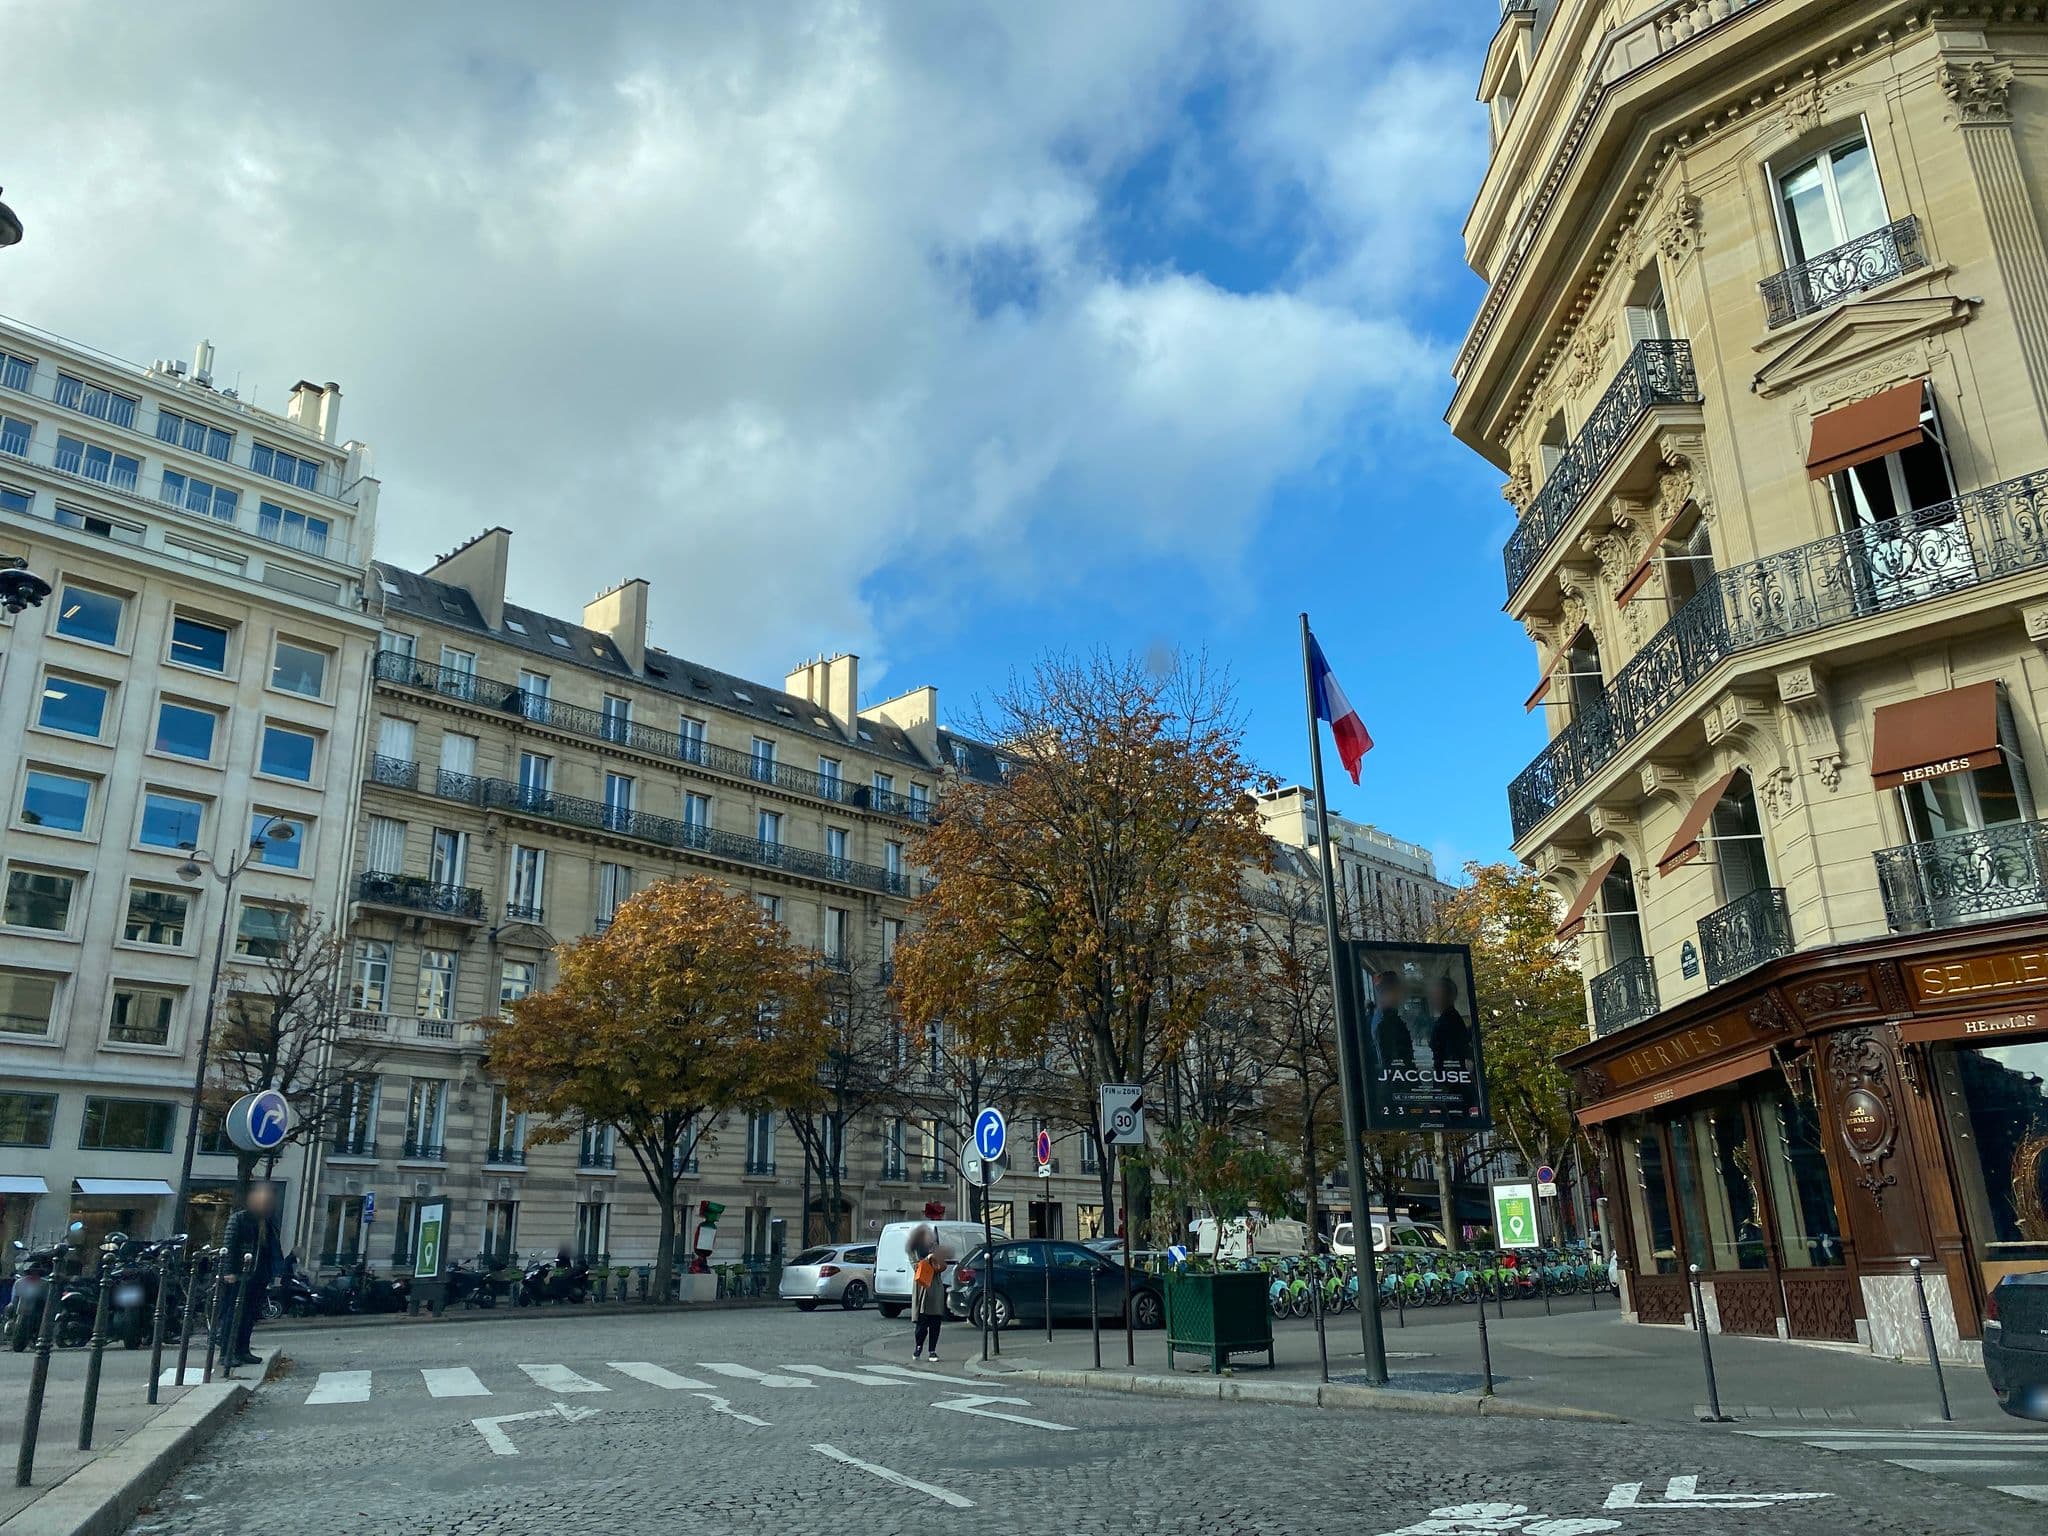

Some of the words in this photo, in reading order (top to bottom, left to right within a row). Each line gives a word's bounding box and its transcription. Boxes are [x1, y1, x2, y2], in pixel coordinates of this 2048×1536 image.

[1922, 952, 2048, 995] SELLIE
[1627, 1024, 1721, 1076] HERMÈS
[1378, 1069, 1471, 1083] J'ACCUSE
[1105, 1087, 1116, 1095] FIN
[1123, 1088, 1140, 1096] ZONE
[1116, 1115, 1132, 1128] 30
